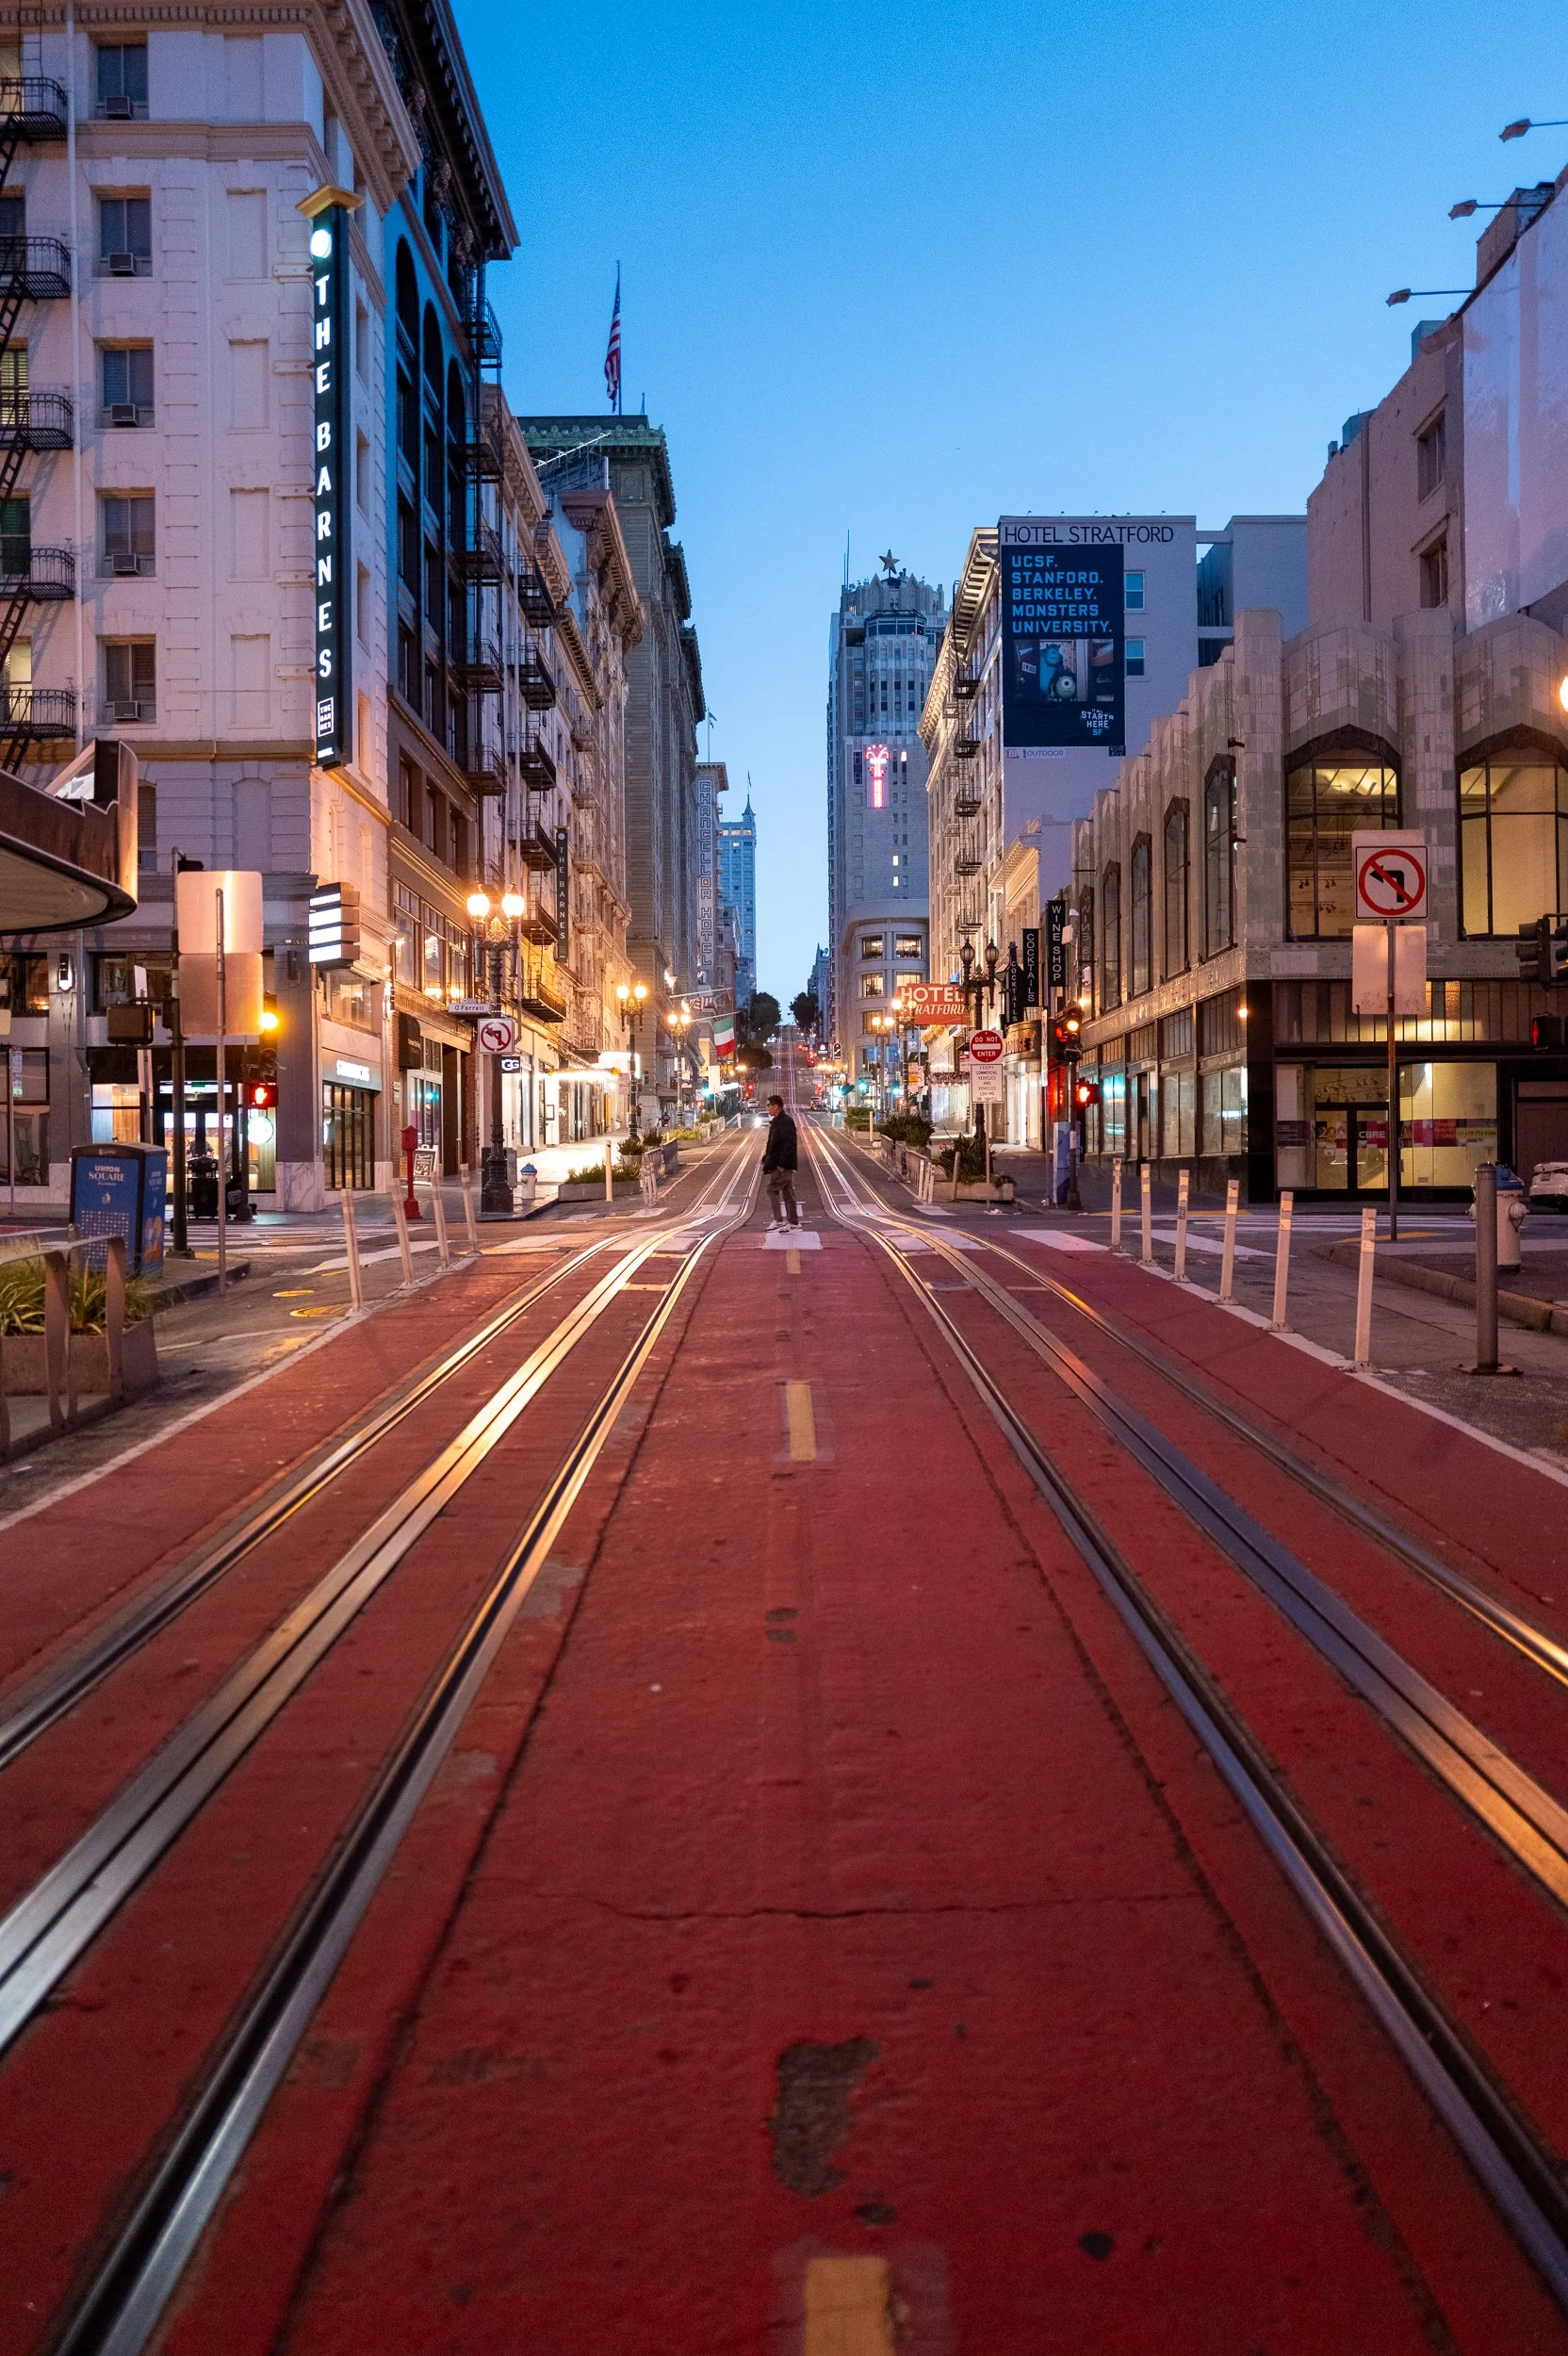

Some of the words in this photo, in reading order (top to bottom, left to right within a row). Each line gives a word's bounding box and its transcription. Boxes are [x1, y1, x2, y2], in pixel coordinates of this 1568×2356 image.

[316, 274, 331, 394] THE
[1004, 527, 1063, 543] HOTEL
[1070, 526, 1174, 543] STRATFORD
[317, 422, 332, 678] BARNES
[1012, 556, 1057, 567] UCSF.
[1012, 572, 1103, 583] STANFORD.
[1012, 588, 1097, 599] BERKELEY.
[1013, 604, 1099, 616] MONSTERS
[1013, 621, 1112, 632] UNIVERSITY.
[1081, 711, 1114, 720] STARTS
[700, 780, 711, 899] CHANCELLOR
[1052, 906, 1062, 941] WINE
[701, 908, 712, 966] HOTEL
[1026, 933, 1036, 1002] COCKTAILS
[1053, 946, 1061, 981] SHOP
[900, 987, 964, 1002] HOTEL
[89, 1171, 124, 1182] SQUARE
